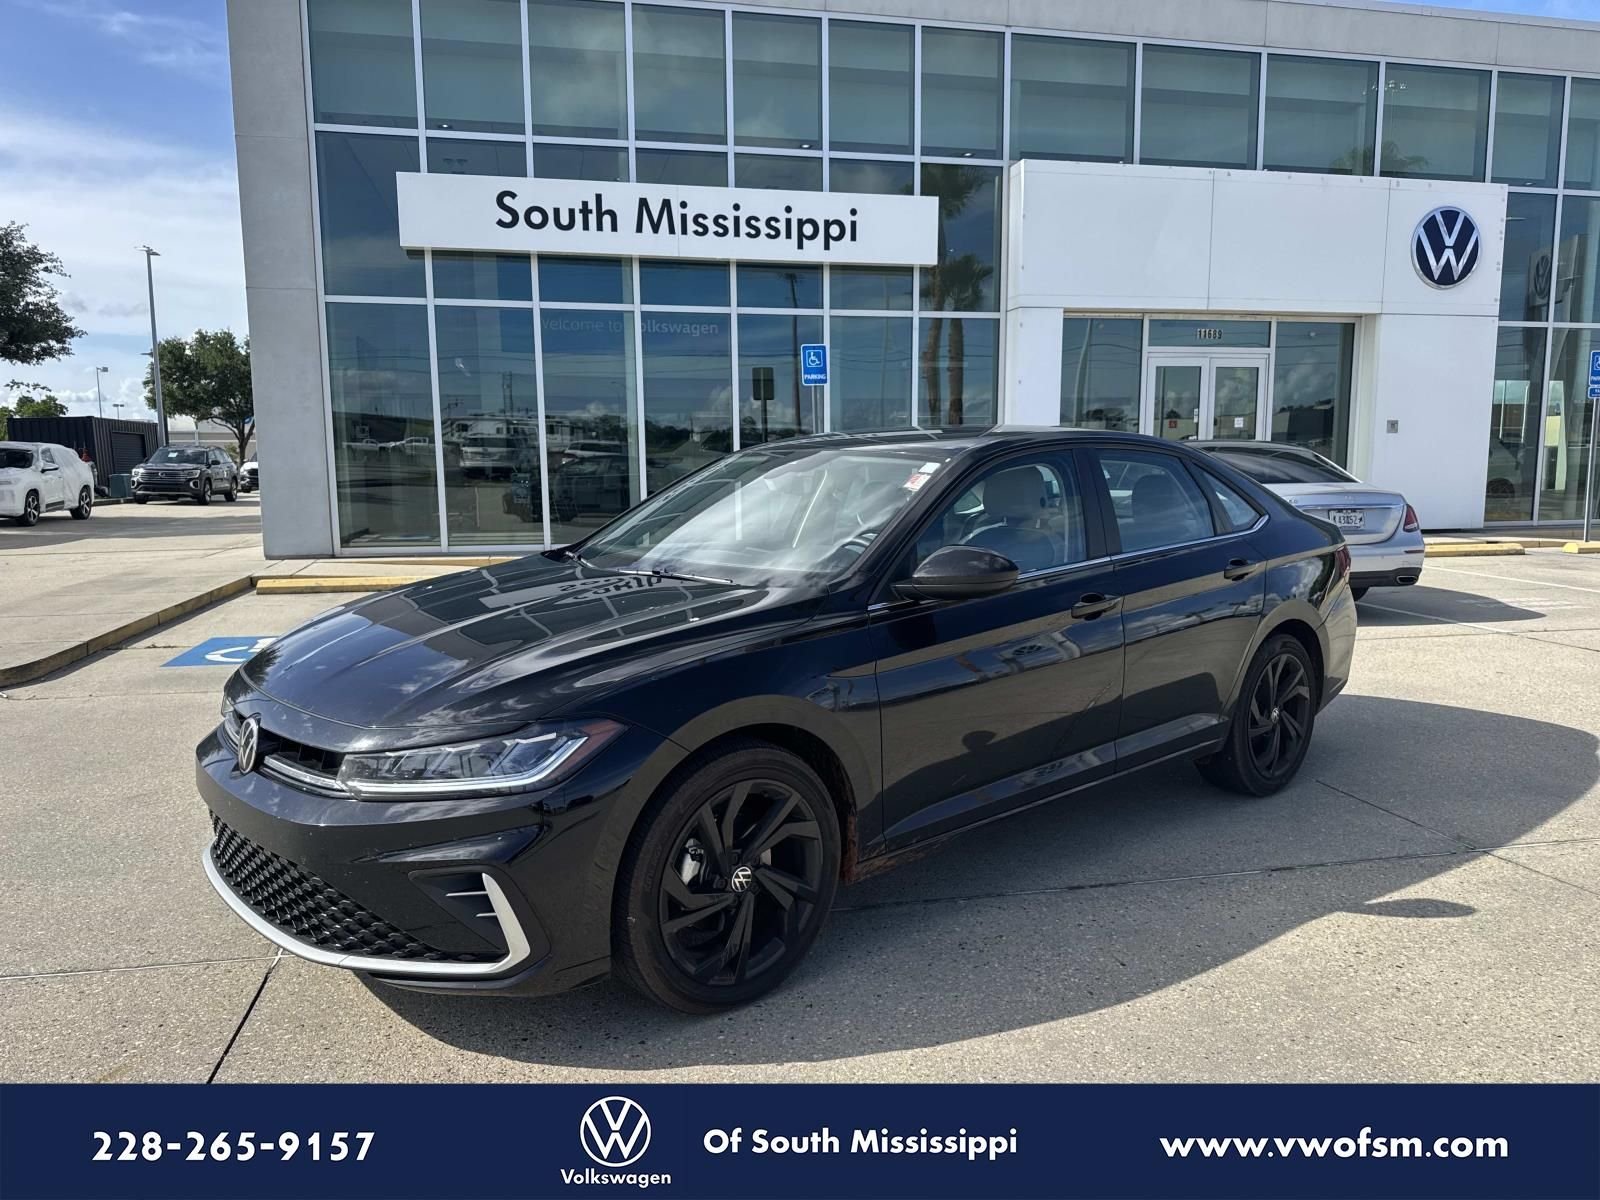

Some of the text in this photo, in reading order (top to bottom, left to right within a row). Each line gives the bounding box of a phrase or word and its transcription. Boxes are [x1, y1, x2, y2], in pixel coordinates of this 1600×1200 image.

[495, 190, 858, 251] South Mississippi
[609, 320, 622, 333] to
[640, 320, 719, 337] olkswagen
[1198, 328, 1223, 340] 11689
